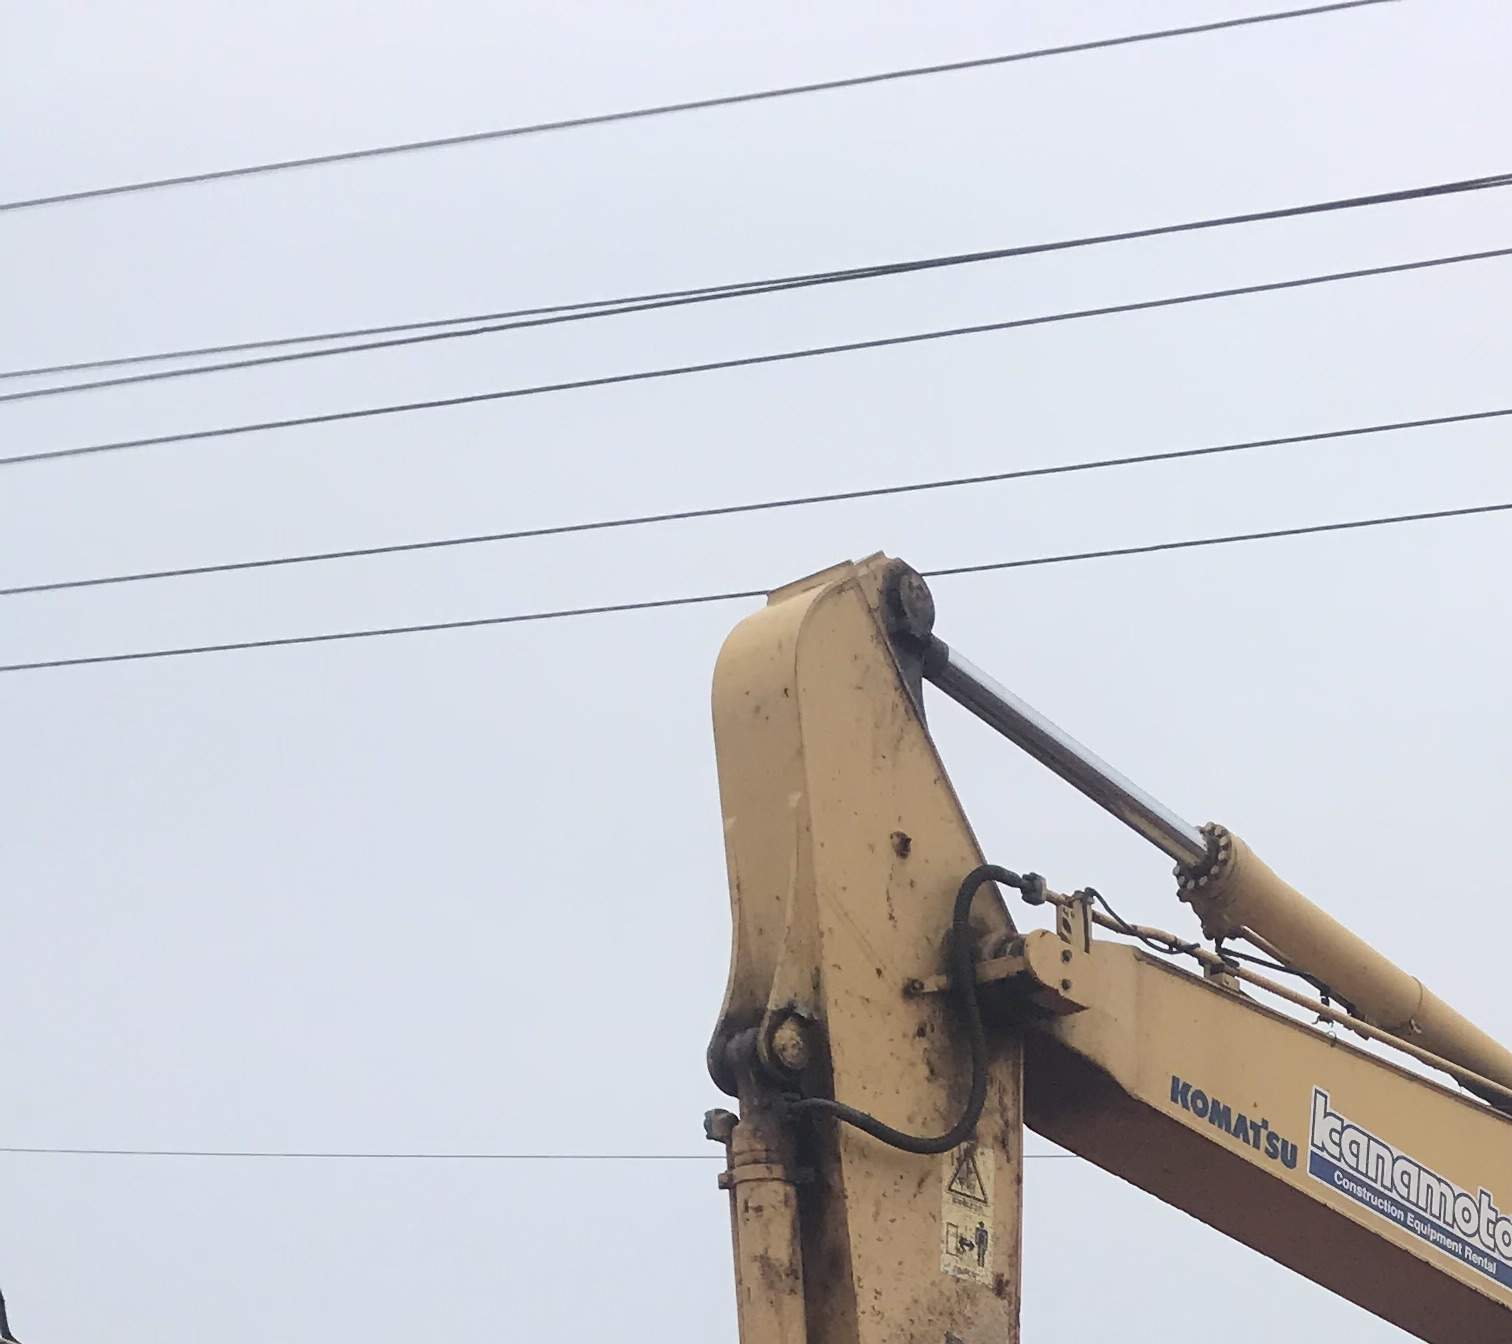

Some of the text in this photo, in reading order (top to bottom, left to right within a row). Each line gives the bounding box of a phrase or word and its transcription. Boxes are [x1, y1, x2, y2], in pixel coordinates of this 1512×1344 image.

[1169, 1075, 1298, 1170] KOMATSU
[1334, 1170, 1497, 1274] Construction Equipment Rental
